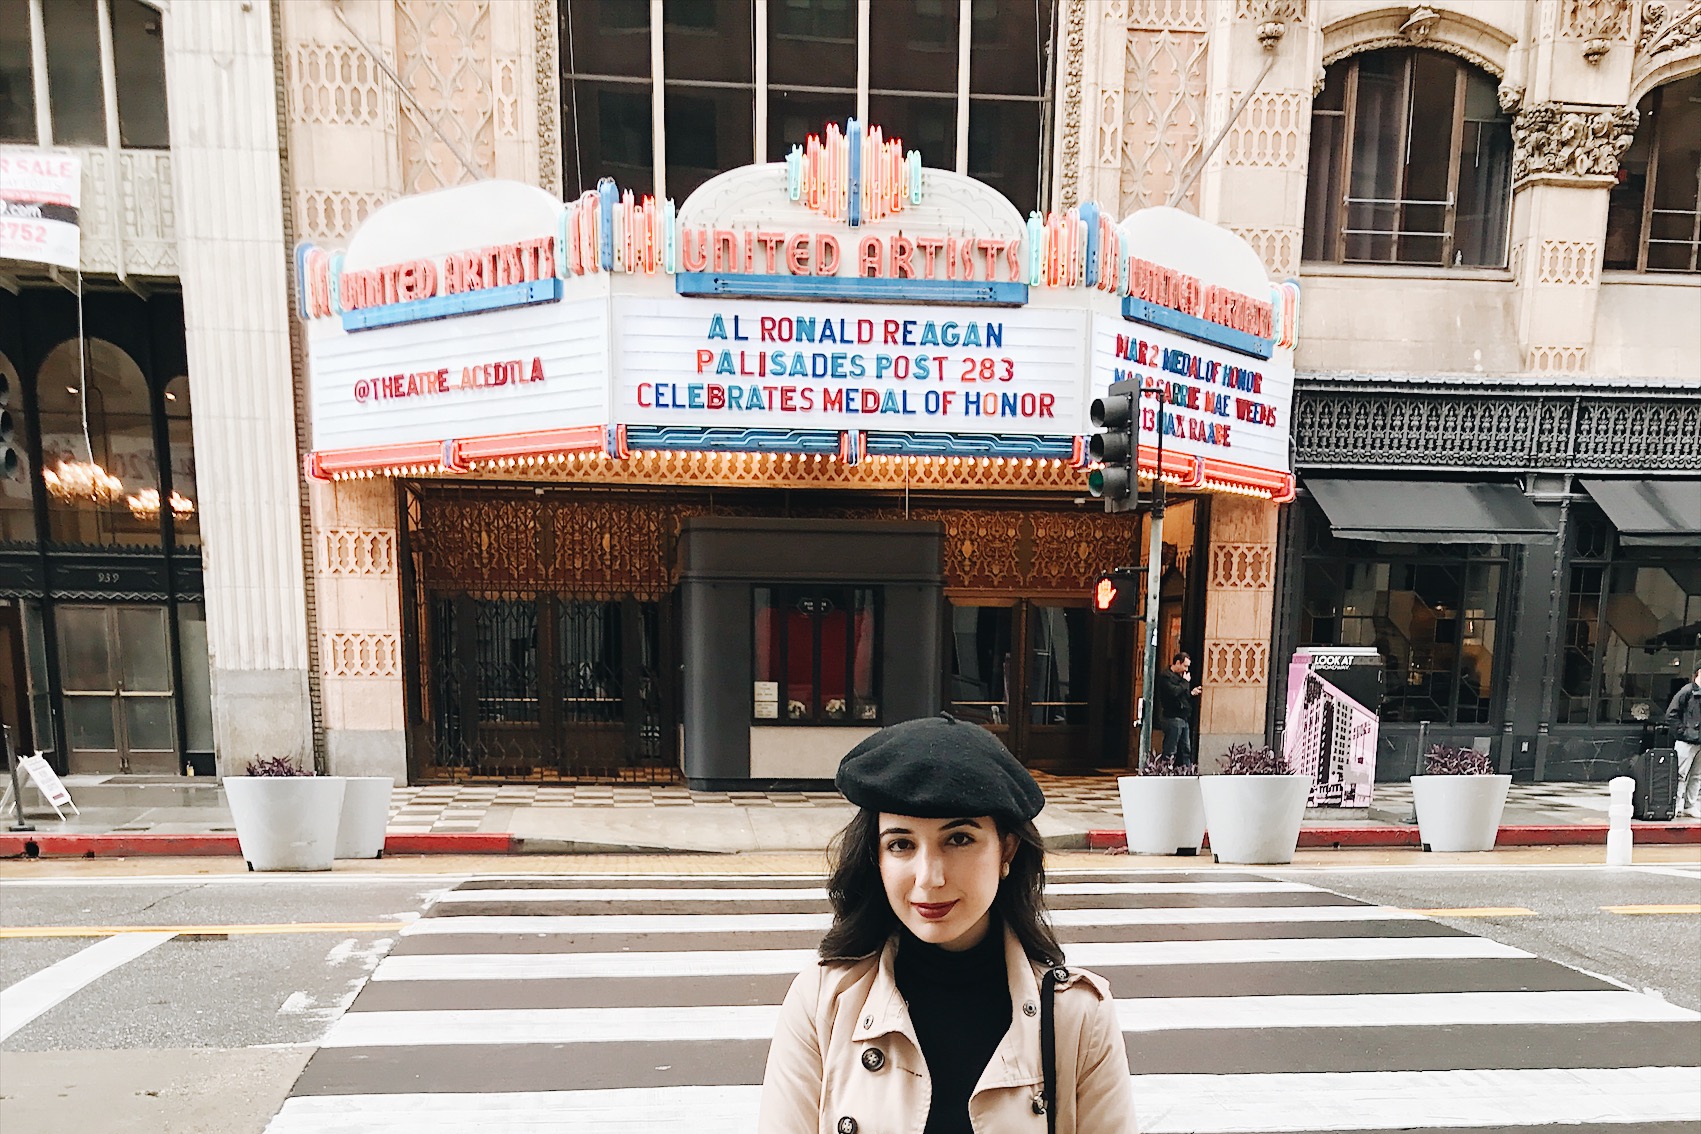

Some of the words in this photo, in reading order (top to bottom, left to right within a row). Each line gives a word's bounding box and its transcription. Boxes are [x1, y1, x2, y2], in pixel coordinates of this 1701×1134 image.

[16, 160, 72, 178] SALE
[682, 229, 841, 275] UNITED
[859, 233, 1021, 281] ARTISTS
[339, 258, 438, 310] UNITED
[444, 237, 556, 294] ARTISTS
[708, 313, 748, 341] AL
[761, 316, 874, 344] RONALD
[884, 320, 1003, 348] REAGAN
[697, 349, 866, 379] PALISADES
[876, 354, 948, 381] POST
[961, 357, 1014, 382] 283
[1116, 333, 1148, 366] MAR
[1149, 345, 1159, 368] 2
[1162, 348, 1204, 380] MEDAL
[1206, 360, 1221, 383] OF
[1222, 364, 1262, 394] HONOR
[637, 382, 814, 412] CELEBRATES
[823, 387, 916, 414] MEDAL
[925, 390, 956, 415] OF
[965, 391, 1055, 418] HONOR
[1205, 391, 1230, 417] MAE
[1143, 407, 1155, 431] 13
[1189, 418, 1231, 447] RAABE
[98, 572, 119, 583] 939
[1315, 655, 1341, 666] LOOK
[1340, 655, 1354, 666] AT
